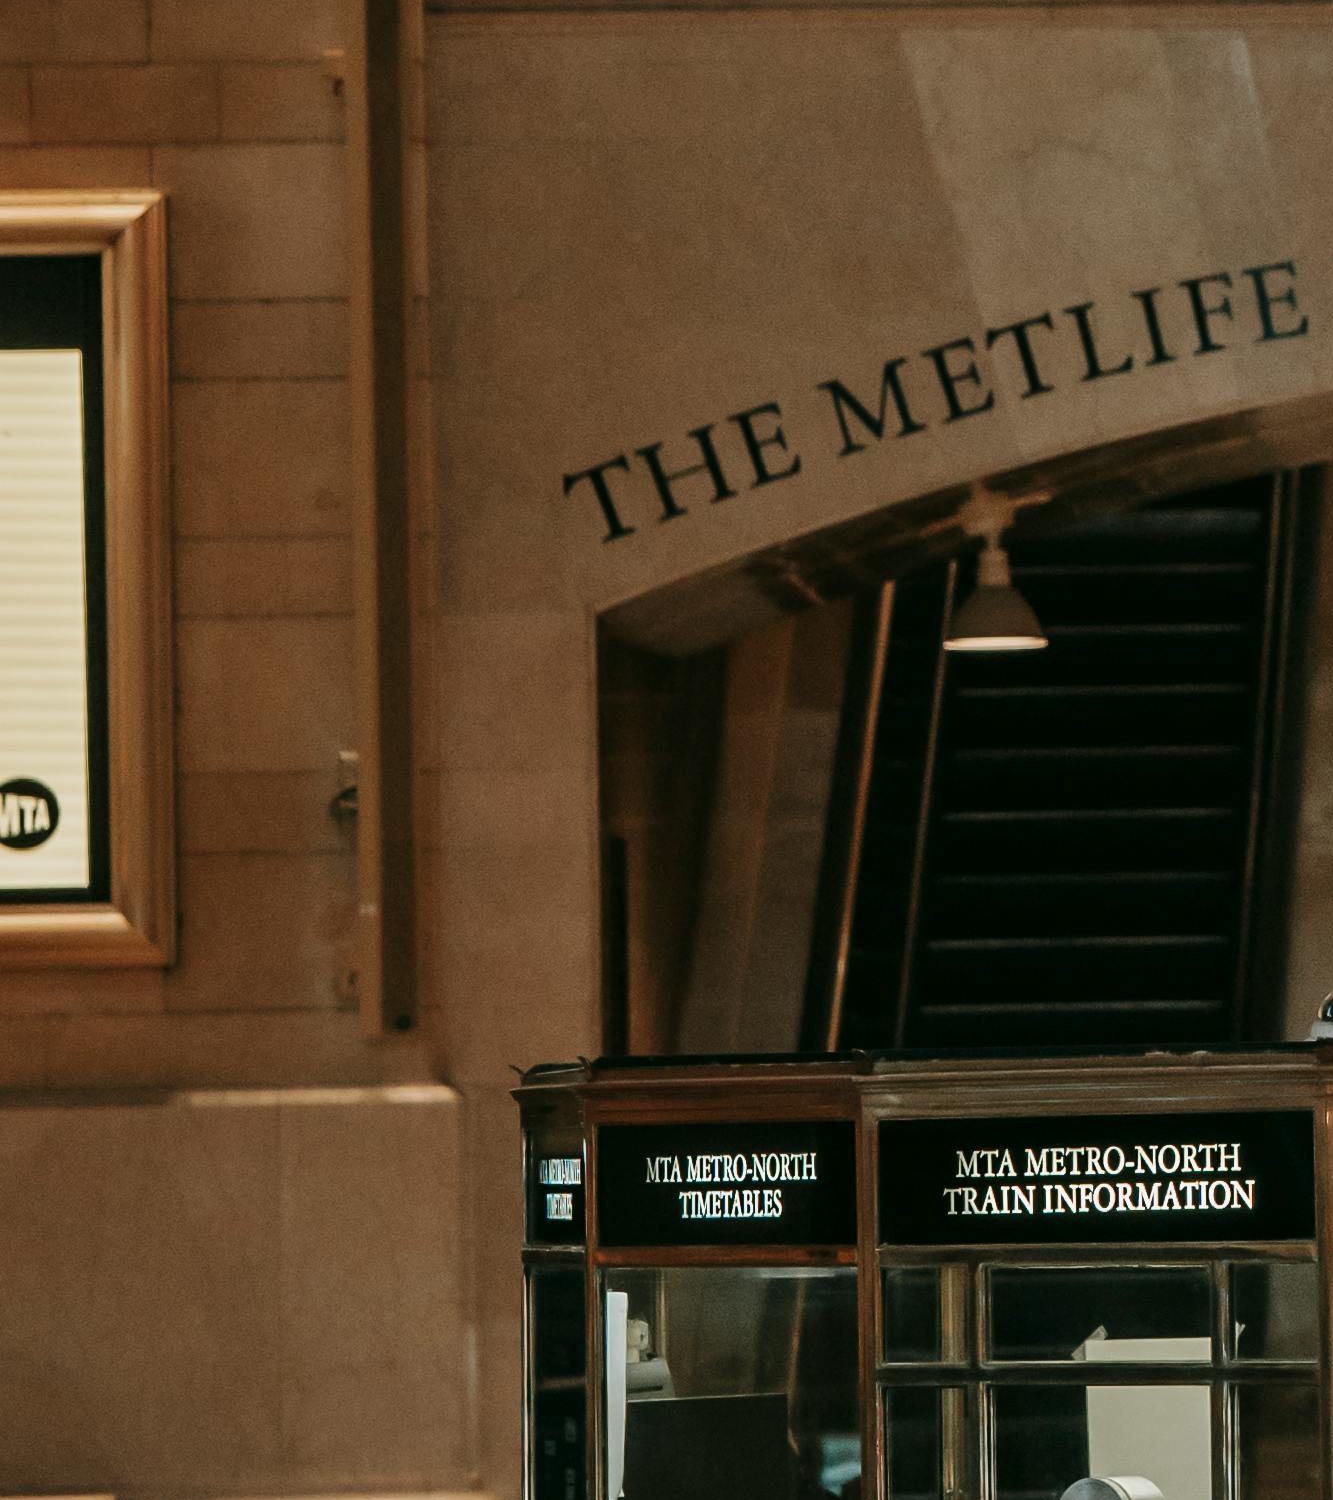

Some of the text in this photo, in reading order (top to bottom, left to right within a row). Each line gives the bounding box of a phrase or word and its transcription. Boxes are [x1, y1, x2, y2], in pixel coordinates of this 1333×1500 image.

[562, 402, 801, 543] THE
[816, 261, 1309, 457] METLIFE
[645, 1152, 817, 1183] MTA METRO-NORTH
[955, 1143, 1242, 1179] MTA METRO-NORTH
[678, 1189, 783, 1219] TIMETABLES
[943, 1179, 1256, 1215] TRAIN INFORMATION
